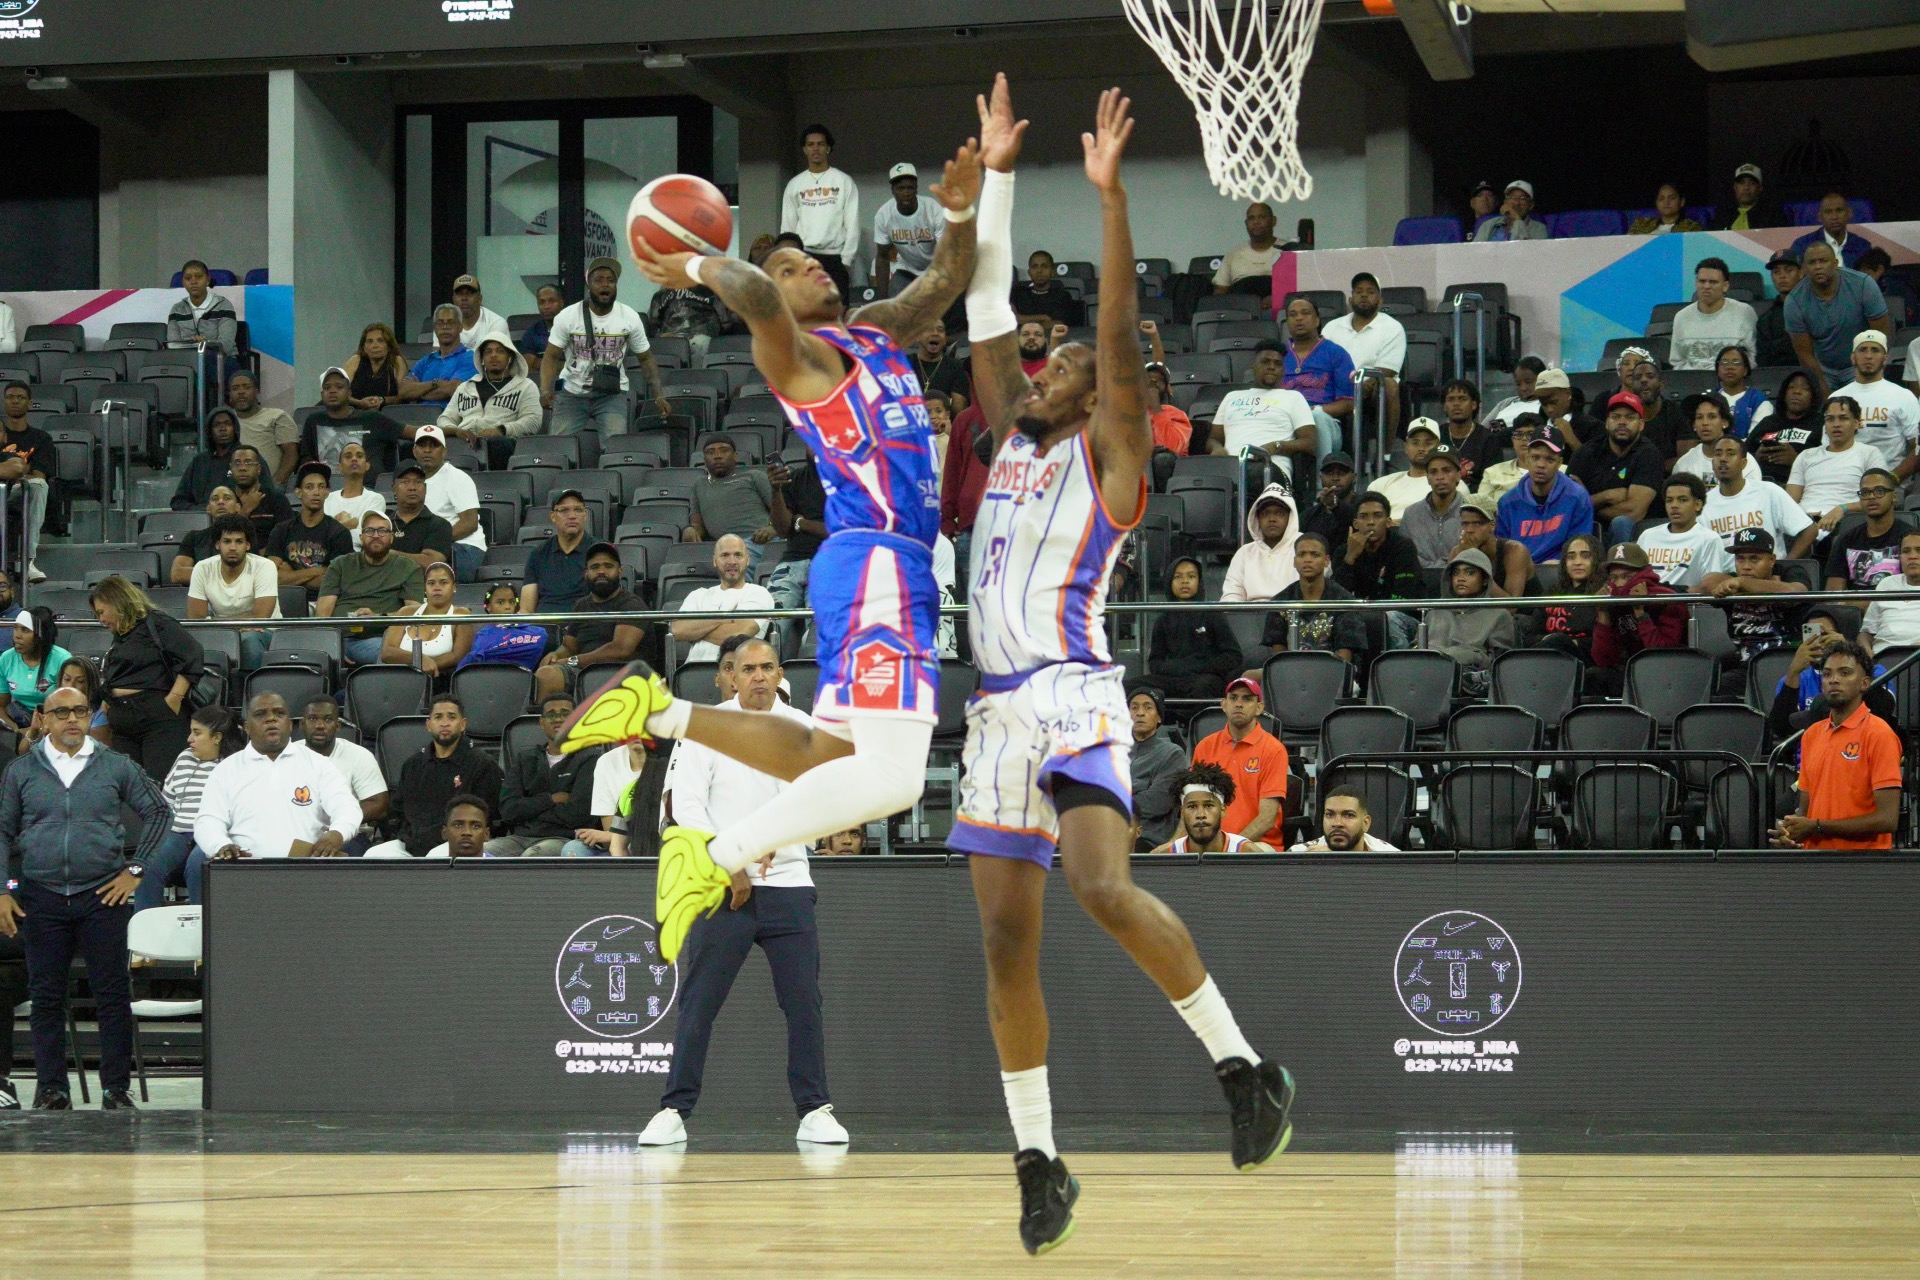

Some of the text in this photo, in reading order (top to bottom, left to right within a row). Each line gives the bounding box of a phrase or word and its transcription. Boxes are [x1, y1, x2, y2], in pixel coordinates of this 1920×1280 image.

[892, 228, 931, 240] HUELLAS
[1710, 510, 1764, 534] HUELLAS
[565, 1059, 670, 1074] 829-747-1742
[1405, 1058, 1513, 1073] 829-747-1742
